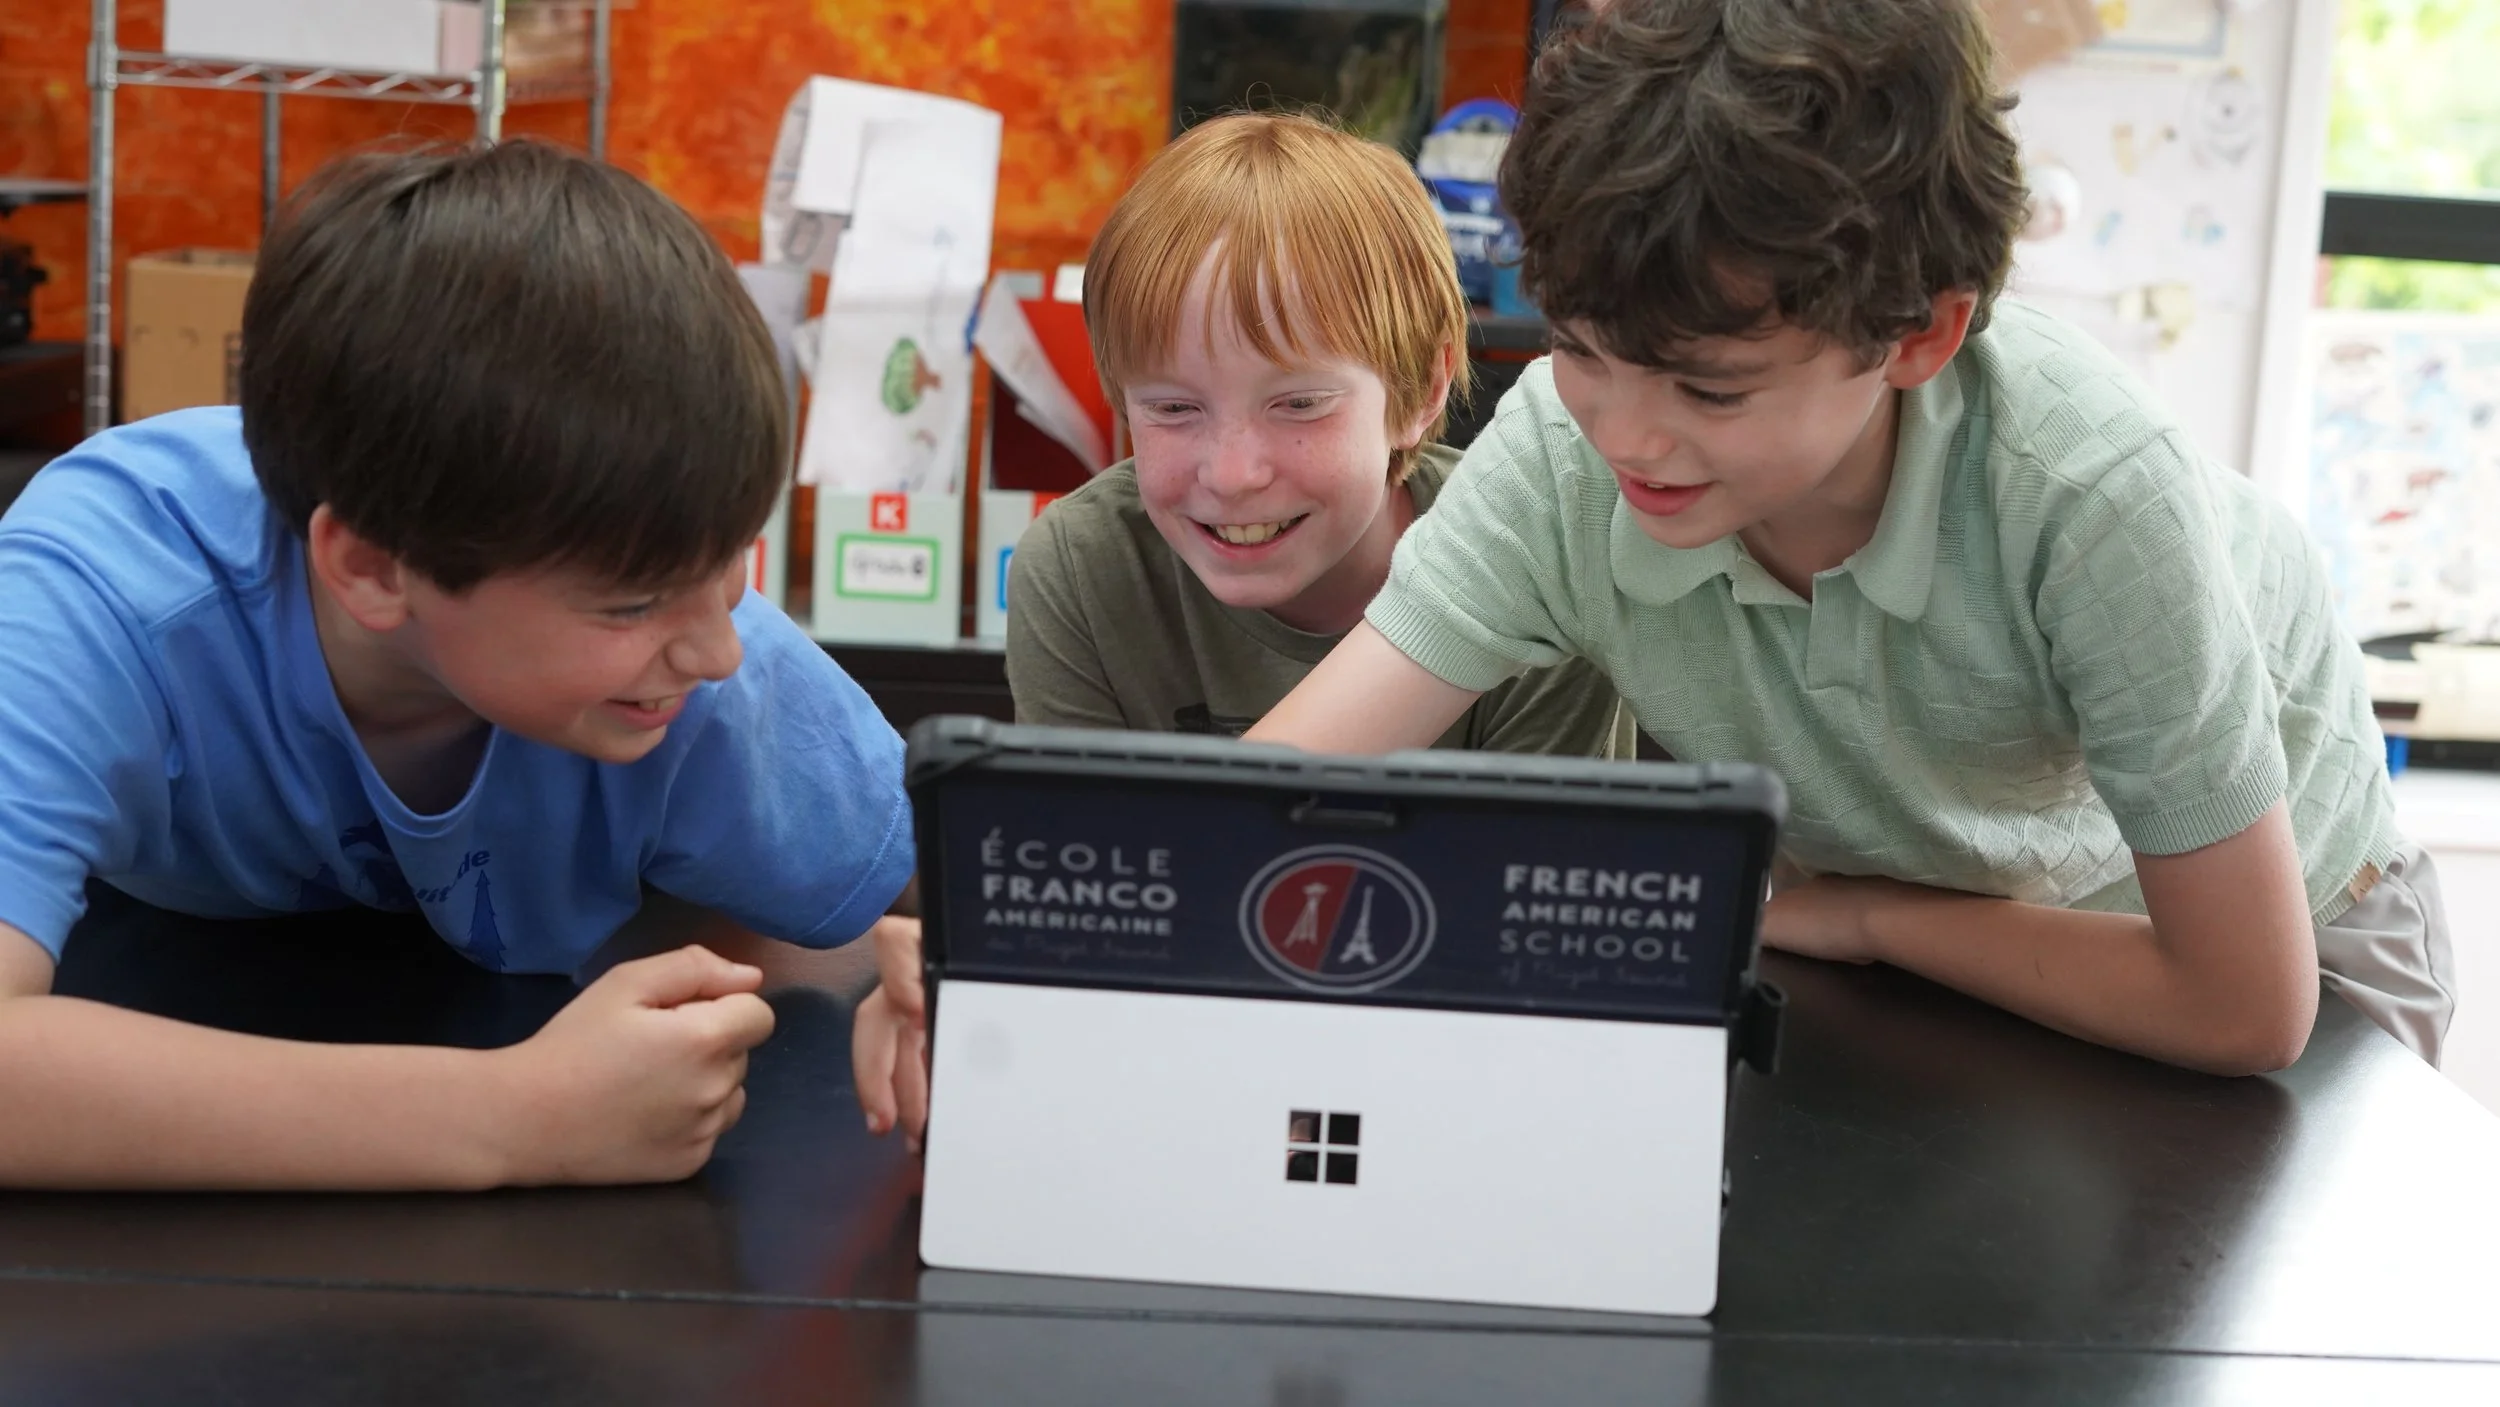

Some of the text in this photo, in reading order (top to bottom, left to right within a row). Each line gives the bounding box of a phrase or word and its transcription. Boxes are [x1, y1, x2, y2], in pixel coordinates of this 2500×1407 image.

[877, 500, 901, 525] K
[457, 850, 490, 879] de
[981, 826, 1172, 878] ÉCOLE
[982, 873, 1178, 912] FRANCO
[1504, 864, 1701, 902] FRENCH
[984, 906, 1172, 936] AMÉRICAINE
[1502, 901, 1697, 931] AMERICAN
[1499, 928, 1690, 963] SCHOOL
